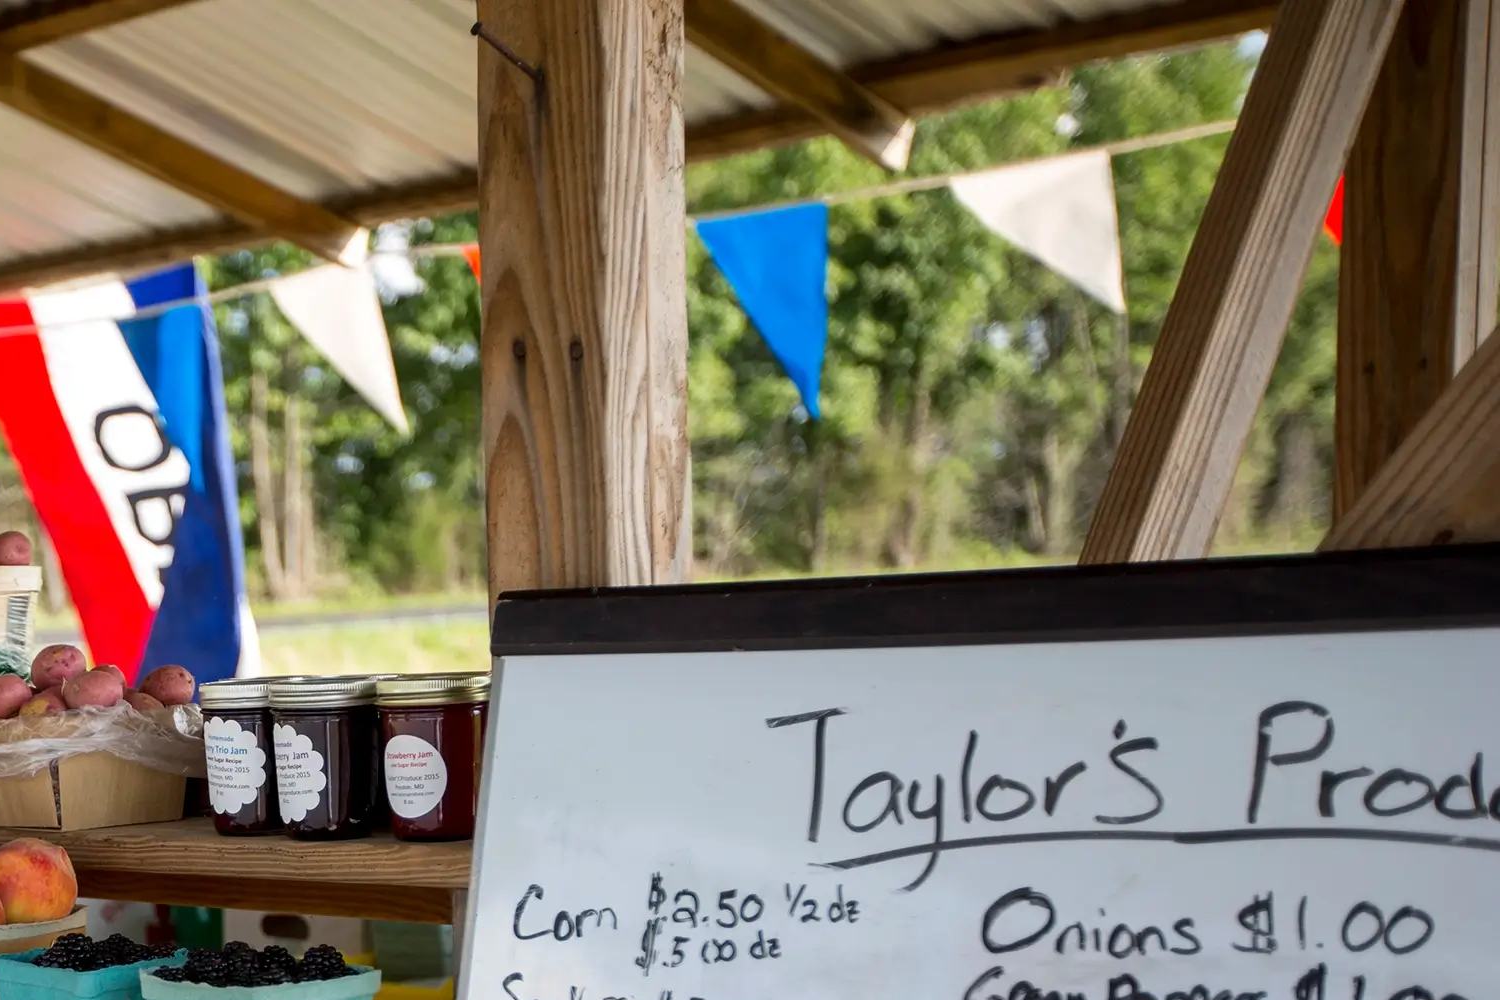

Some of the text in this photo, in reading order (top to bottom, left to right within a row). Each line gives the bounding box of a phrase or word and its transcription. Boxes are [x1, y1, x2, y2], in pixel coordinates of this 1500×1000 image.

[216, 745, 229, 754] Trio
[230, 747, 248, 755] Jam
[417, 750, 433, 758] Jam
[292, 752, 309, 760] Jam
[423, 772, 440, 780] 2015
[765, 700, 1500, 893] Taylor's Prod
[513, 884, 618, 941] Corn
[982, 886, 1436, 958] Onions $1.00
